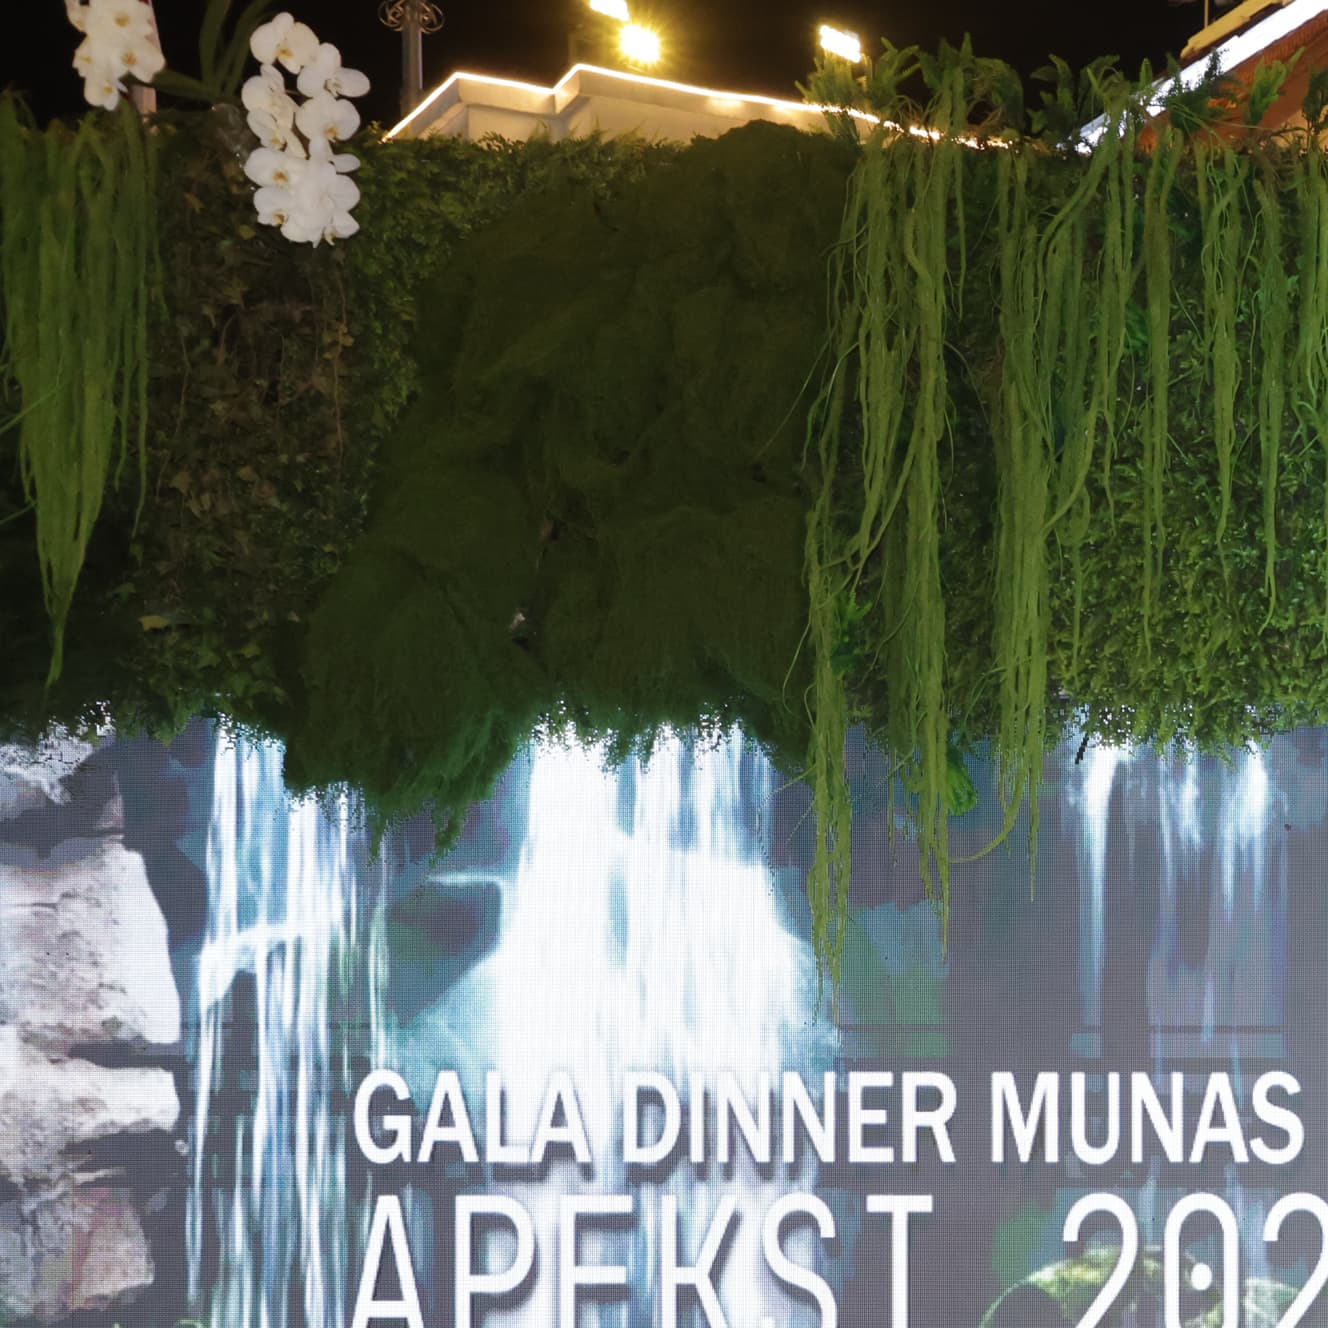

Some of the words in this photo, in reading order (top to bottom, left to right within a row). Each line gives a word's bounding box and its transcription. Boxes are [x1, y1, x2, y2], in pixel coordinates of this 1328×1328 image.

[352, 1069, 591, 1167] GALA
[623, 1069, 958, 1165] DINNER
[991, 1069, 1305, 1165] MUNAS
